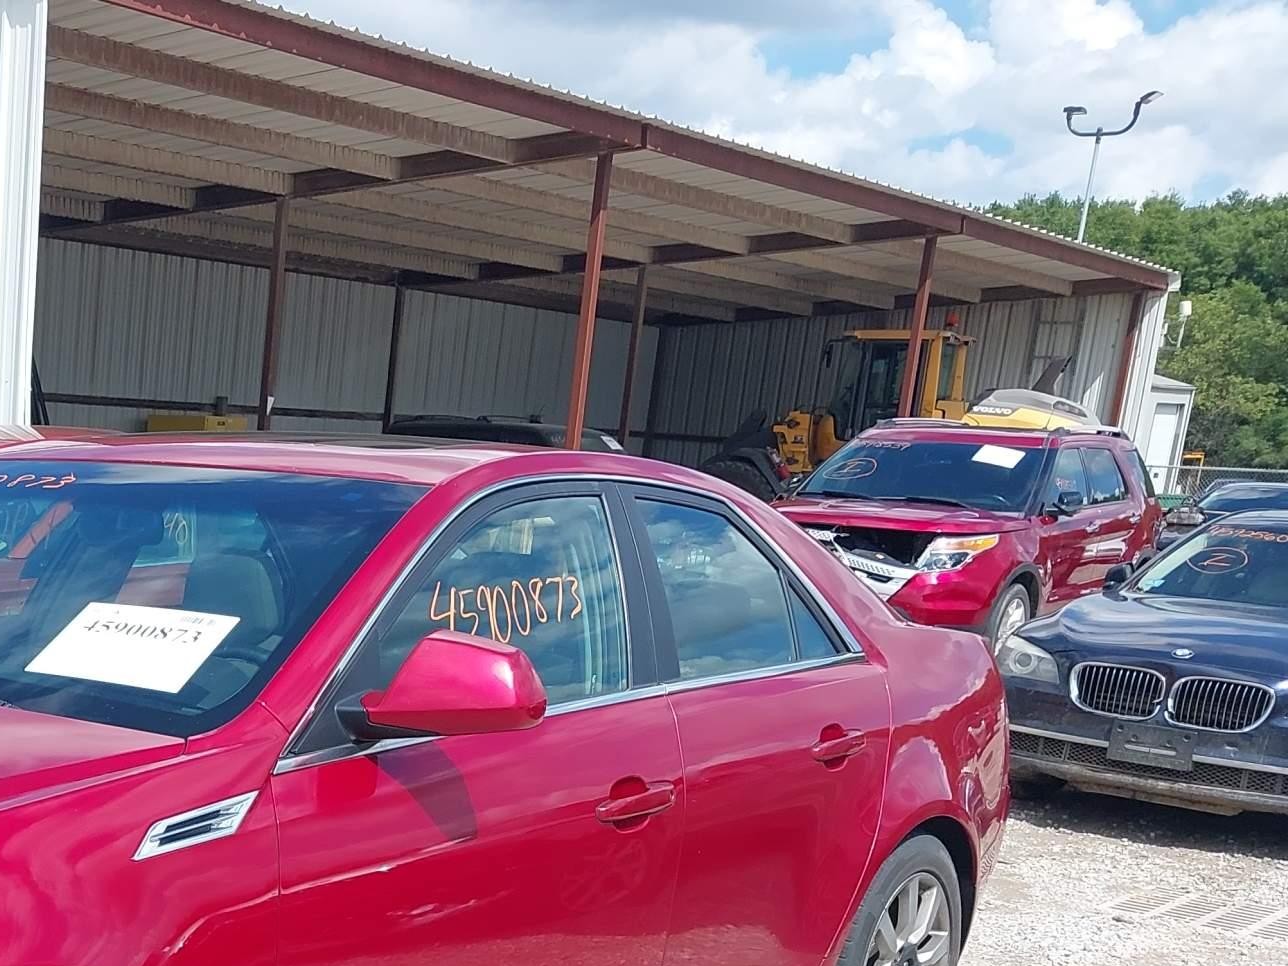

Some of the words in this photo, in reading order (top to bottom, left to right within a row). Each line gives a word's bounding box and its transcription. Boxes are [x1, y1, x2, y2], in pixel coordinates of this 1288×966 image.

[972, 405, 1012, 415] VOLVO
[429, 575, 582, 644] 45900873
[83, 619, 202, 644] 45900873
